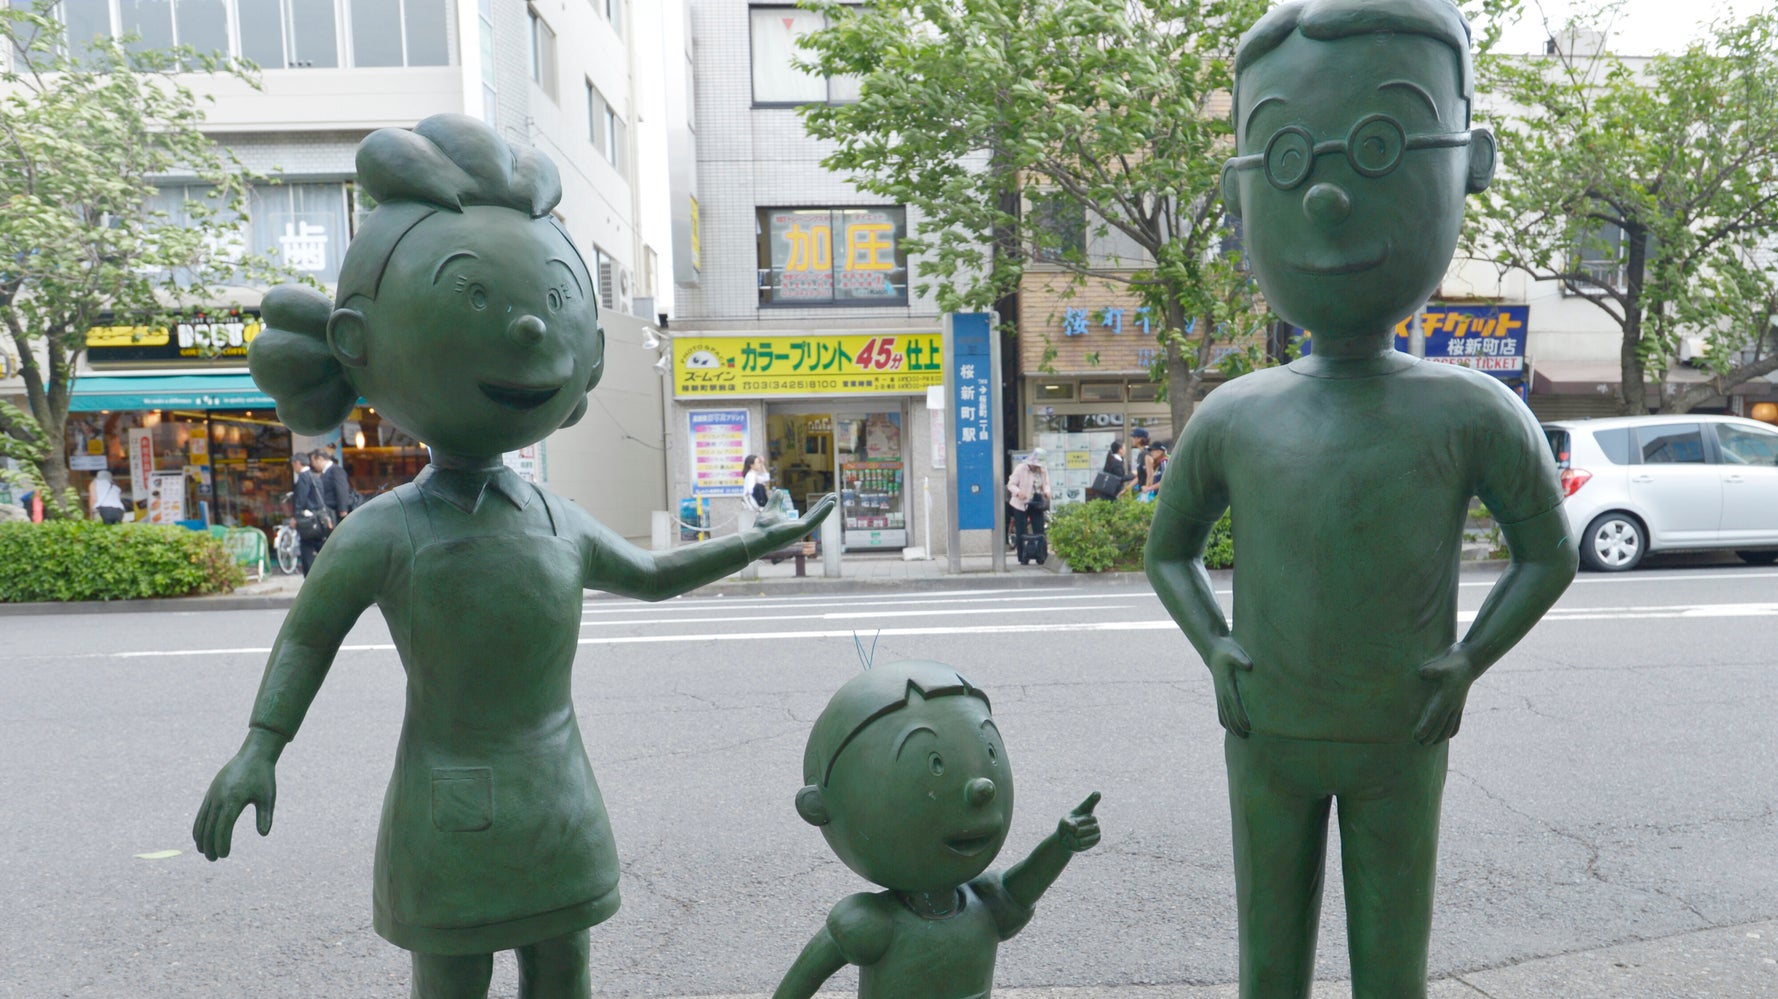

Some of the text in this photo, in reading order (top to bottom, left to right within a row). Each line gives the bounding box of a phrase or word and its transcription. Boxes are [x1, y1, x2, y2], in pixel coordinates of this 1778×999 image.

[785, 223, 895, 272] 加圧
[1447, 337, 1517, 356] 桜新町店
[1475, 357, 1517, 369] TICKET
[960, 364, 976, 442] 桜新町駅
